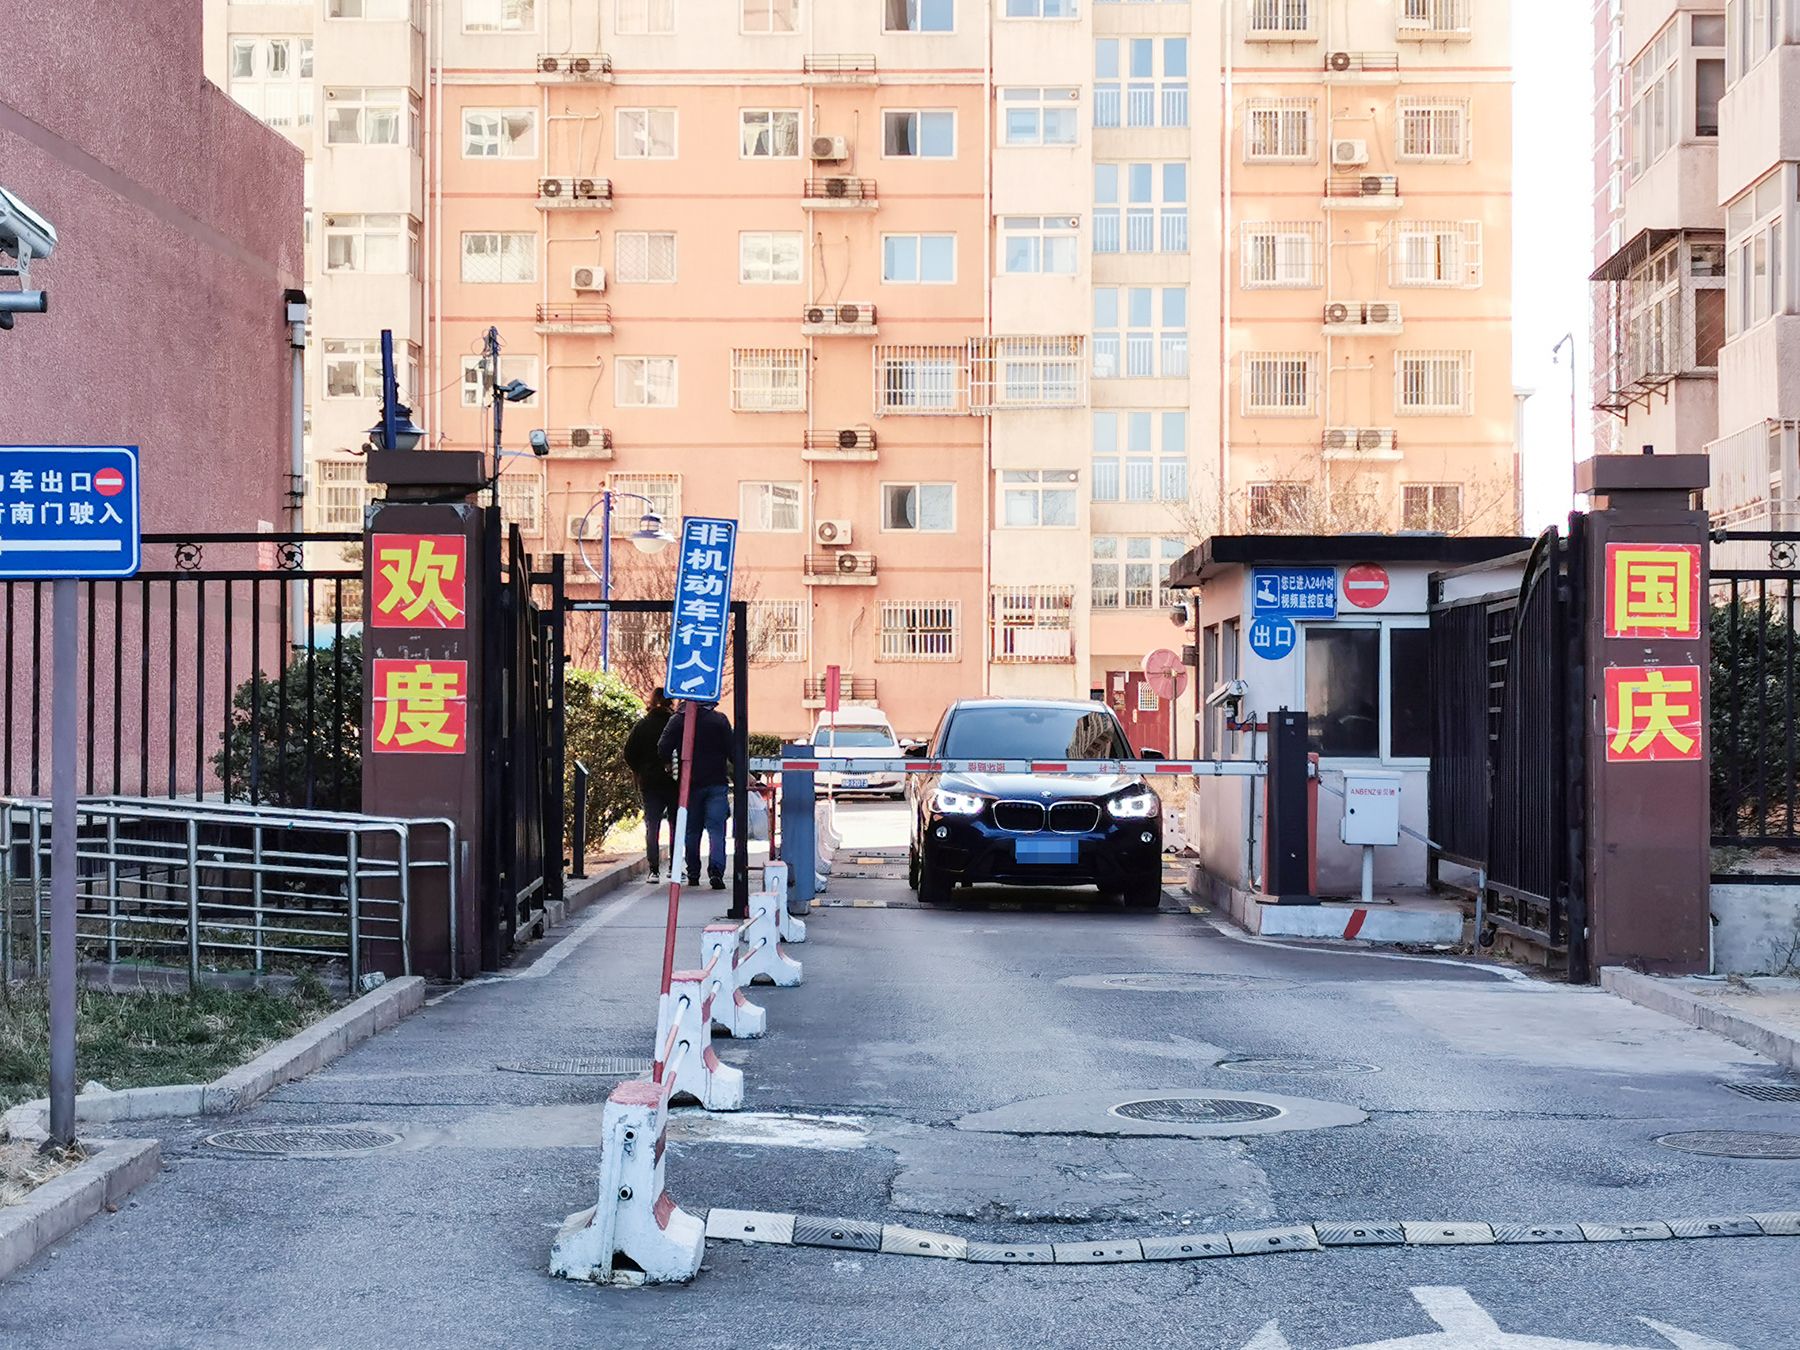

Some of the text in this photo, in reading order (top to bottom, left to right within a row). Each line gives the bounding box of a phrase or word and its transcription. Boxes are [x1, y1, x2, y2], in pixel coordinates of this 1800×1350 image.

[0, 470, 91, 493] 车出口
[0, 501, 123, 525] 南门驶入
[1281, 575, 1334, 590] 您已进入24小时
[675, 524, 729, 672] 非机动车行人
[1281, 593, 1334, 608] 视频监控区域
[1254, 624, 1291, 647] 出口
